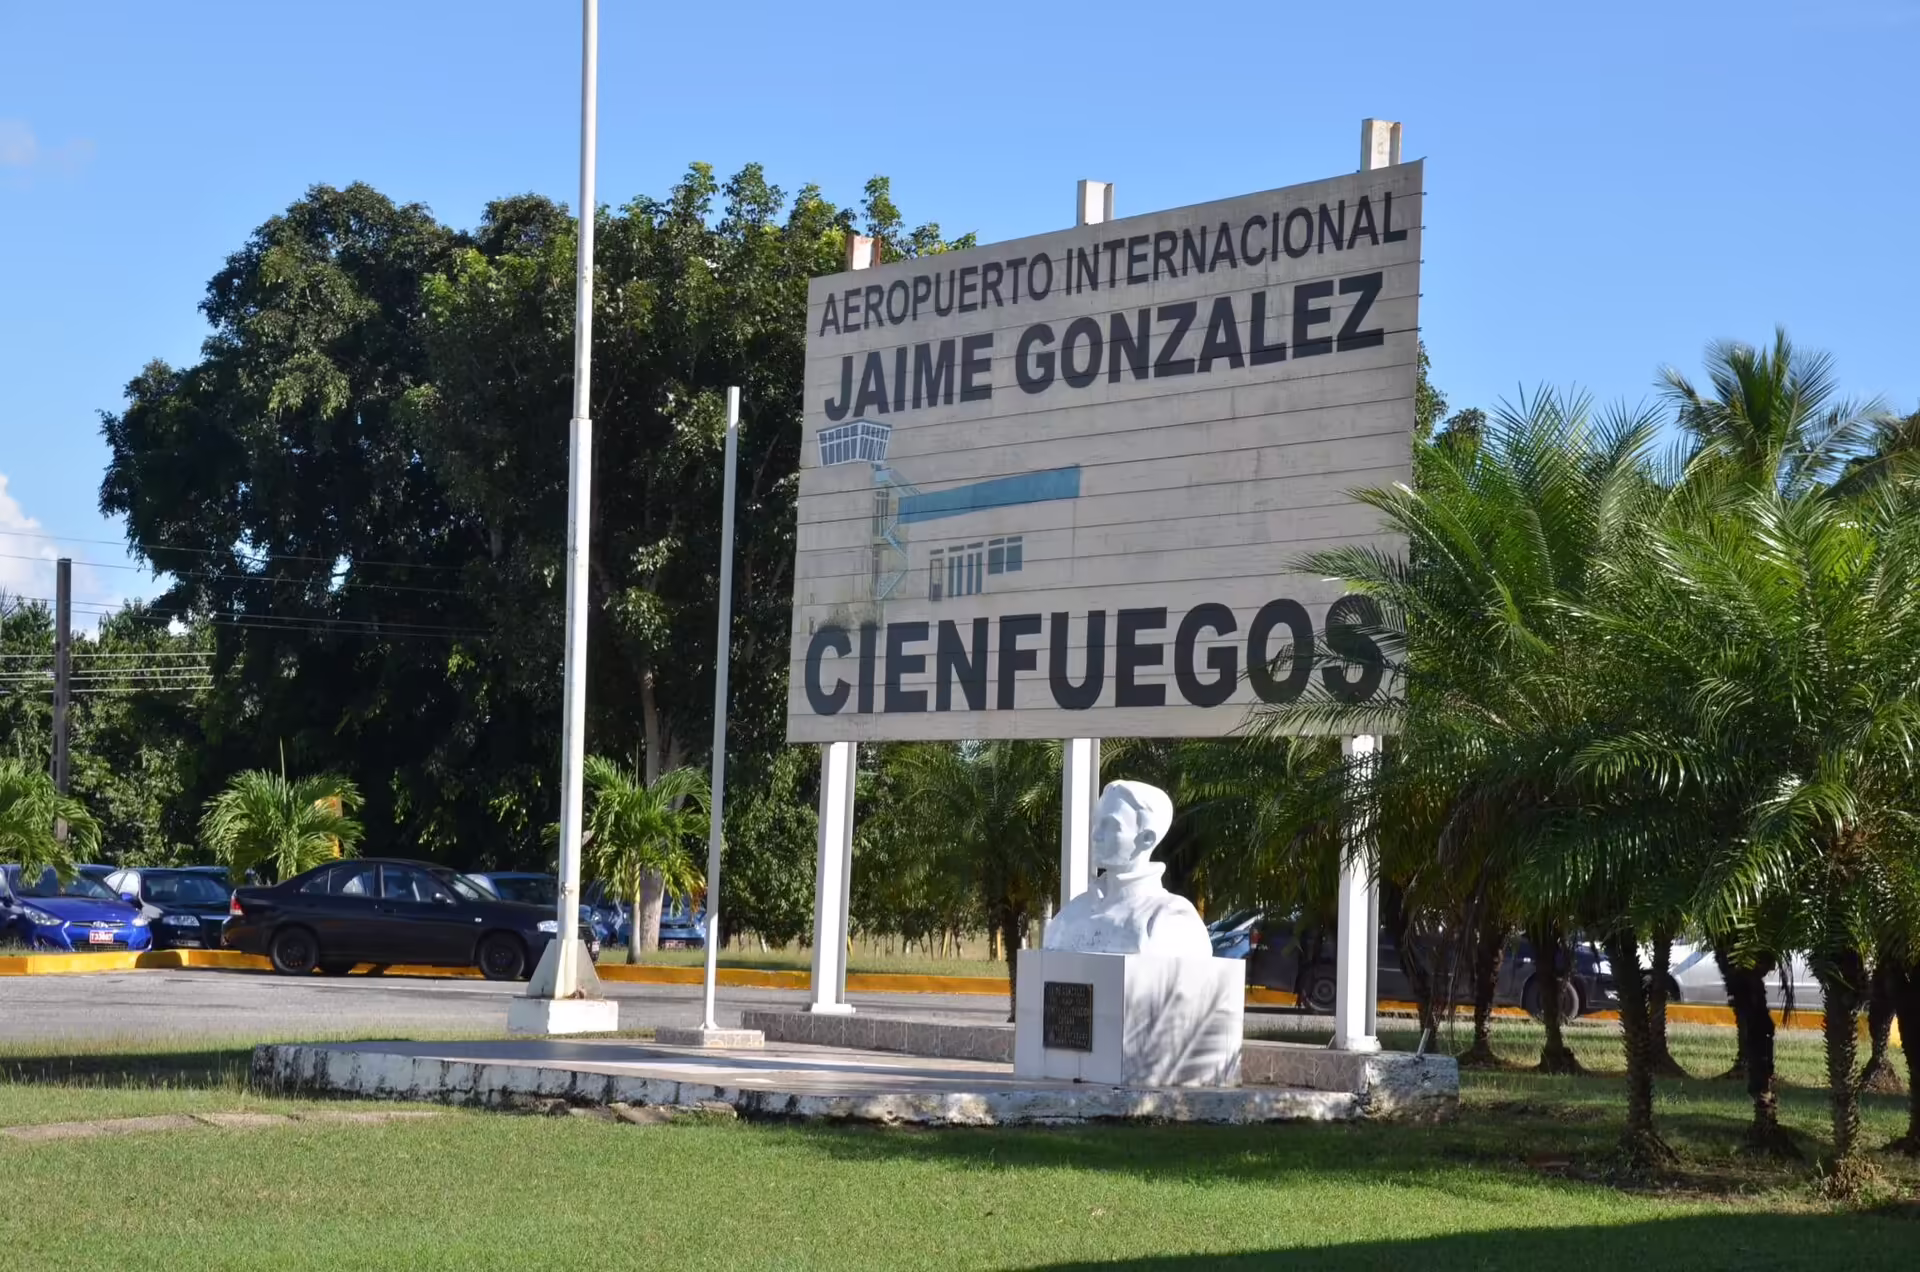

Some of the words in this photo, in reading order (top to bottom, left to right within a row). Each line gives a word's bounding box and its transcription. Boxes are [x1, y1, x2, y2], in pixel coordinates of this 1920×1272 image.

[820, 252, 1053, 337] AEROPUERTO
[1065, 191, 1408, 296] INTERNACIONAL
[825, 333, 994, 421] JAIME
[1015, 272, 1384, 394] GONZALEZ
[804, 594, 1384, 716] CIENFUEGOS
